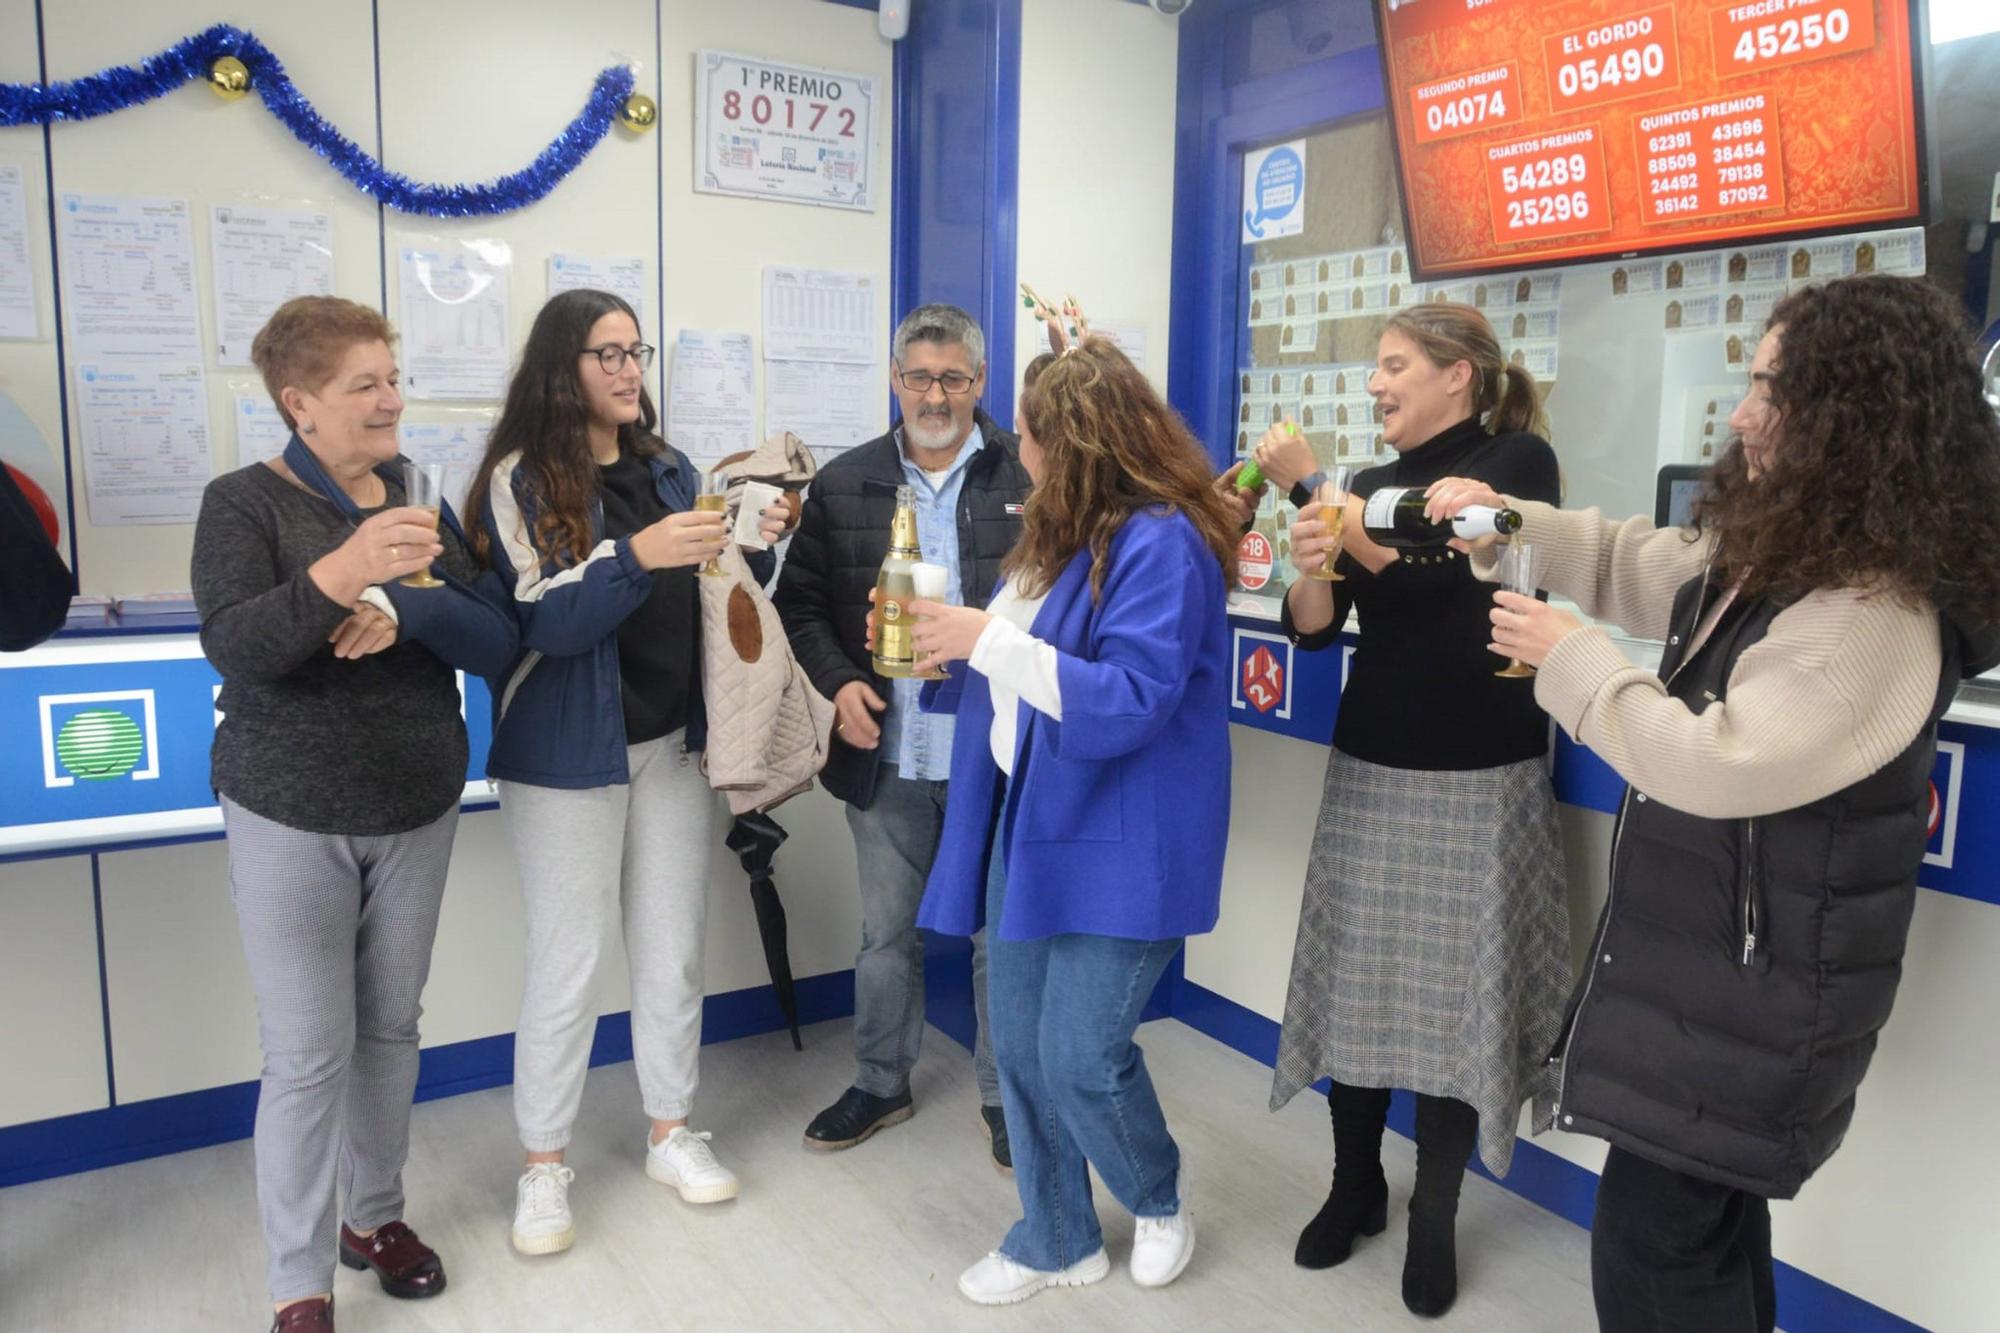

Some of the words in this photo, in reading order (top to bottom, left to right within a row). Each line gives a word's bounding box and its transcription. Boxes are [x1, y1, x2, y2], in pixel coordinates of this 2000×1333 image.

[1728, 0, 1784, 23] TERCER
[1563, 36, 1583, 54] EL
[1587, 16, 1653, 48] GORDO
[1733, 8, 1849, 62] 45250
[760, 70, 842, 101] PREMIO
[1417, 78, 1466, 100] SEGUNDO
[1468, 67, 1508, 88] PREMIO
[1558, 43, 1664, 96] 05490
[723, 90, 856, 137] 80172
[1427, 90, 1506, 131] 04074
[1640, 108, 1699, 132] QUINTOS
[1702, 95, 1765, 118] PREMIOS
[1488, 140, 1540, 160] CUARTOS
[1541, 129, 1593, 150] PREMIOS
[1649, 131, 1692, 153] 62391
[1712, 118, 1763, 141] 43696
[1502, 153, 1586, 193] 54289
[1648, 152, 1697, 174] 88509
[1713, 141, 1766, 164] 38454
[1651, 173, 1698, 194] 24492
[1718, 162, 1764, 184] 79138
[1507, 190, 1589, 228] 25296
[1655, 195, 1698, 215] 36142
[1719, 185, 1768, 205] 87092
[1242, 538, 1264, 557] +18
[1249, 683, 1272, 706] 2
